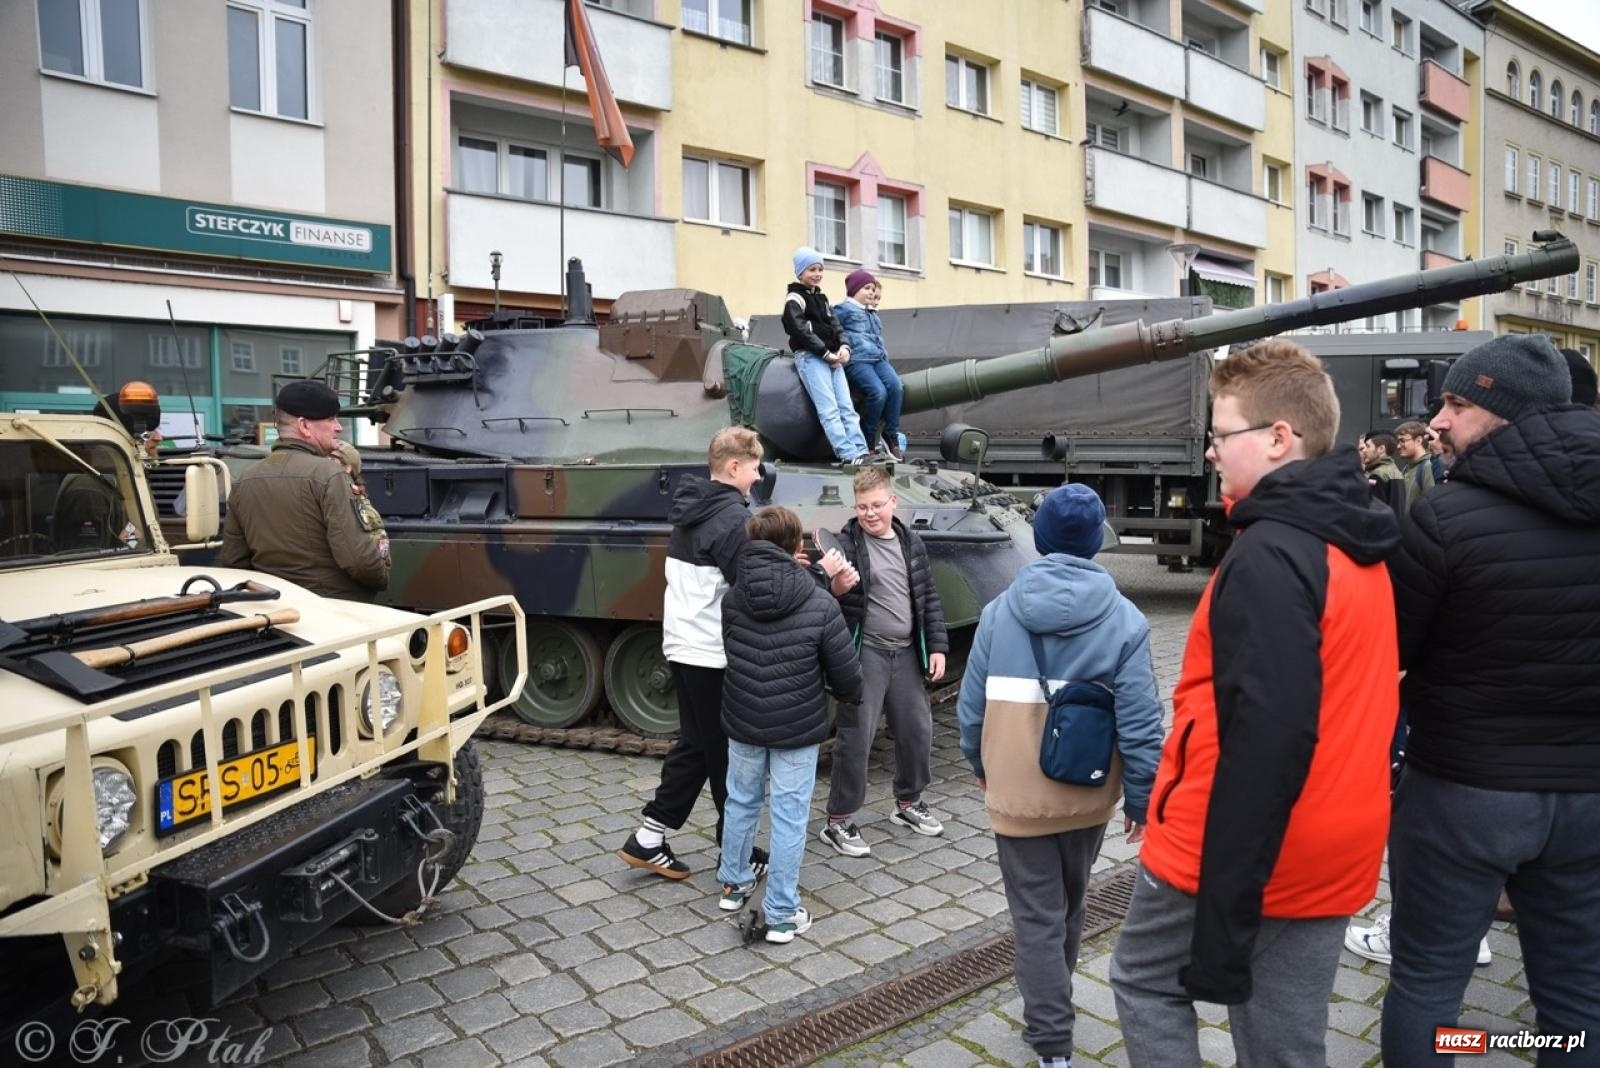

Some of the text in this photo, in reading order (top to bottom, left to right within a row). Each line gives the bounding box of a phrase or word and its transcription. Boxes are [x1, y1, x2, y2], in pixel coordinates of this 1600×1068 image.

[194, 213, 365, 247] STEFCZYK FINANSE
[250, 752, 280, 791] 05
[160, 809, 172, 822] PL
